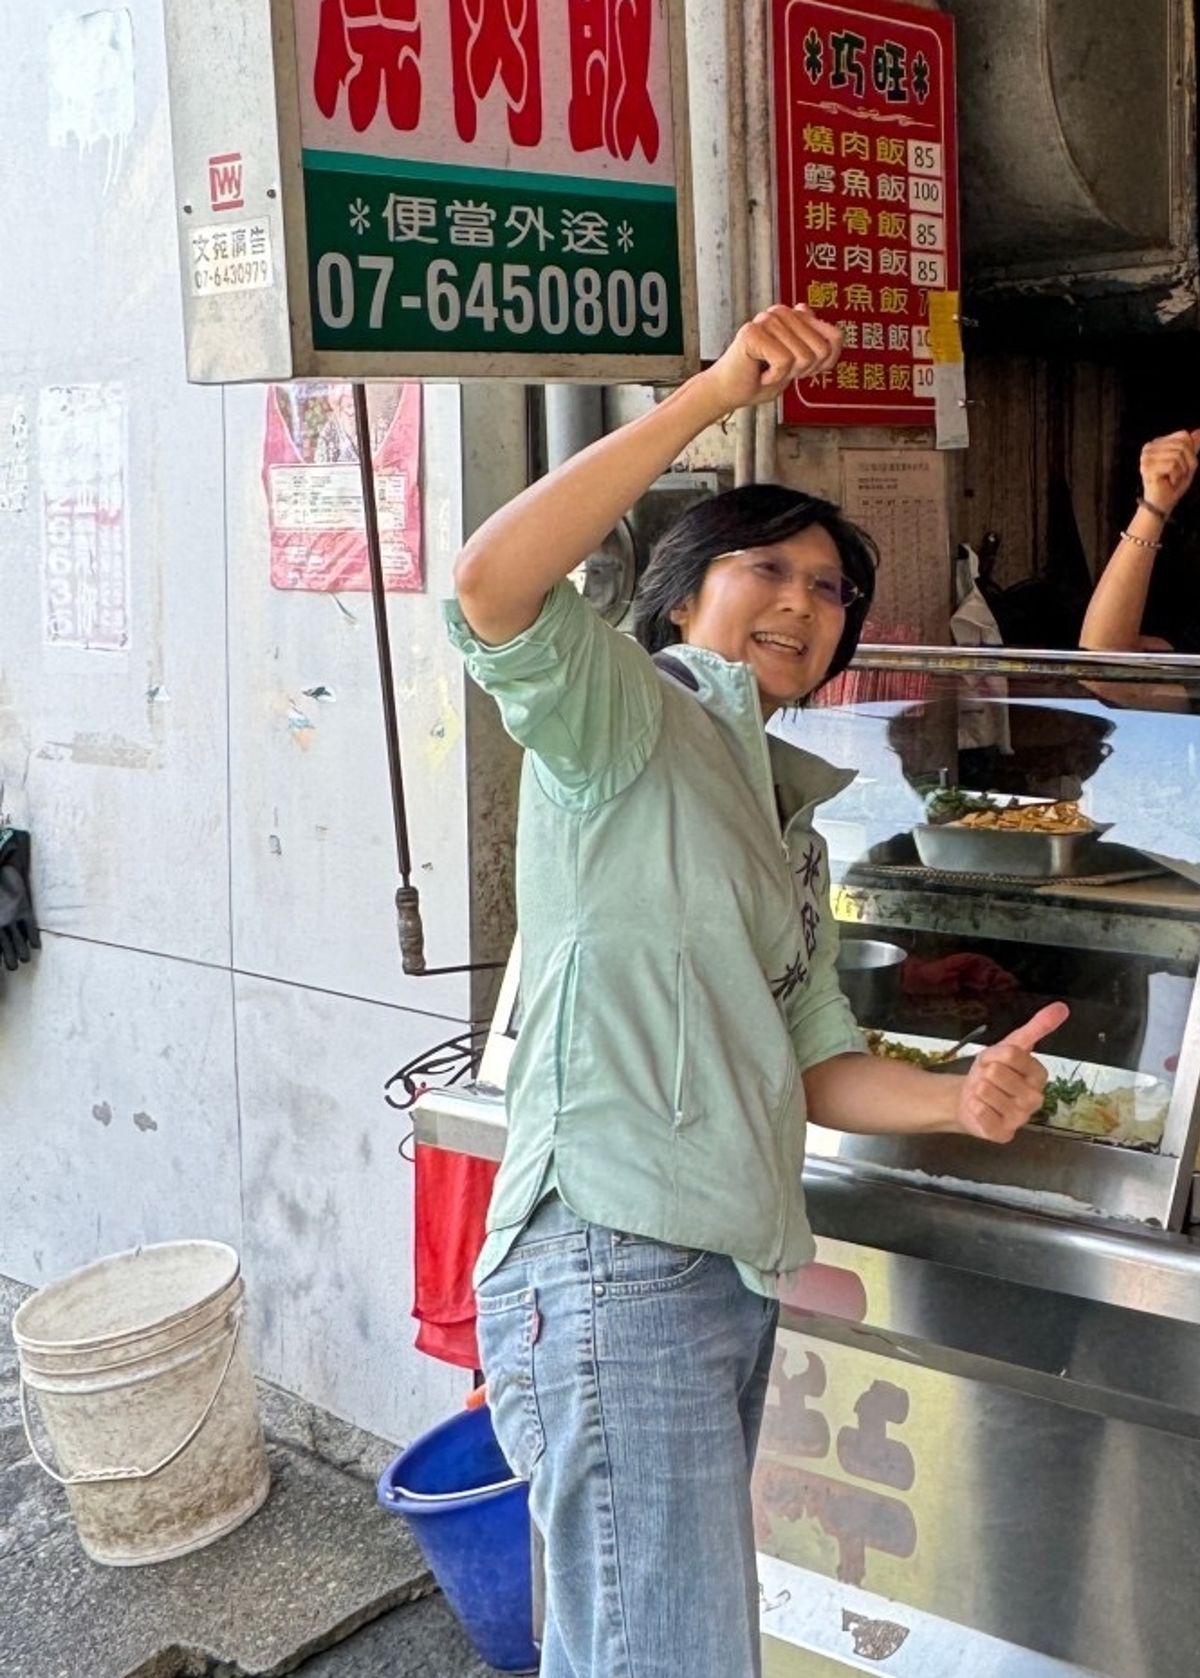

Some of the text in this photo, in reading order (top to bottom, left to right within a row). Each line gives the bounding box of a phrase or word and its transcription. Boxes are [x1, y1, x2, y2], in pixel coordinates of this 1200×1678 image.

[802, 122, 935, 169] 燒肉飯 85
[803, 162, 939, 204] 鱈魚飯 100
[193, 225, 266, 263] 文苑廣告
[381, 193, 610, 256] 便當外送
[804, 202, 937, 247] 排骨飯 85
[917, 260, 938, 282] 85
[316, 251, 670, 338] 07-6450809
